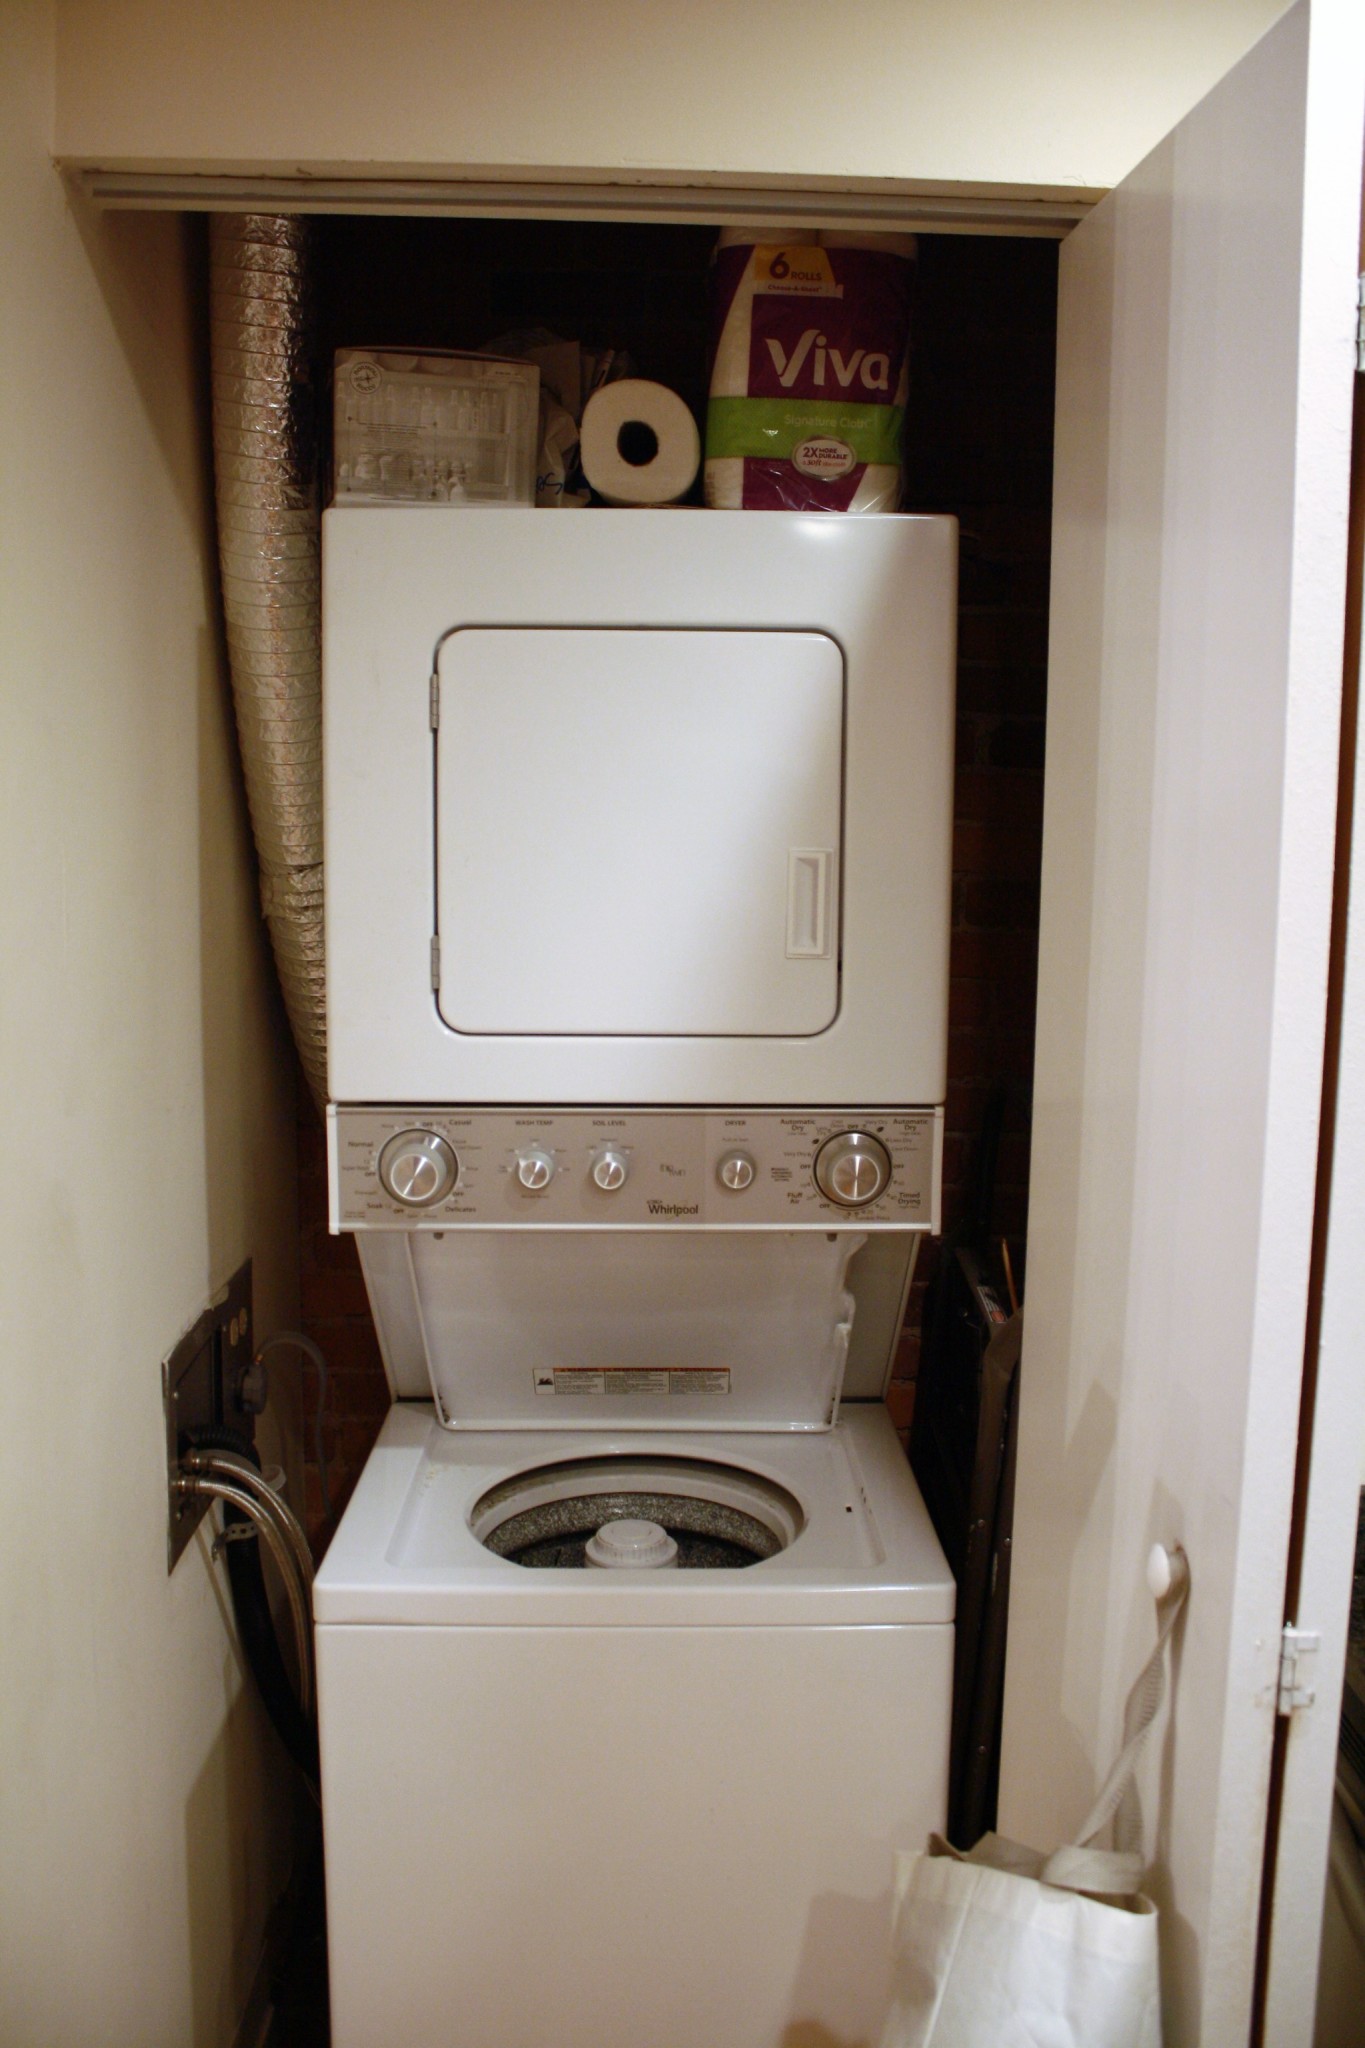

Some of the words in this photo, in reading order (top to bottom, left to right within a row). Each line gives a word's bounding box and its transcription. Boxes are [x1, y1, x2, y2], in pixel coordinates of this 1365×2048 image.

[769, 251, 790, 279] 6
[791, 271, 822, 281] ROLLS
[765, 329, 890, 390] Viva
[784, 414, 837, 428] Signature
[802, 447, 818, 458] 2X
[898, 1198, 921, 1206] Drying
[648, 1204, 699, 1217] Whirlpool
